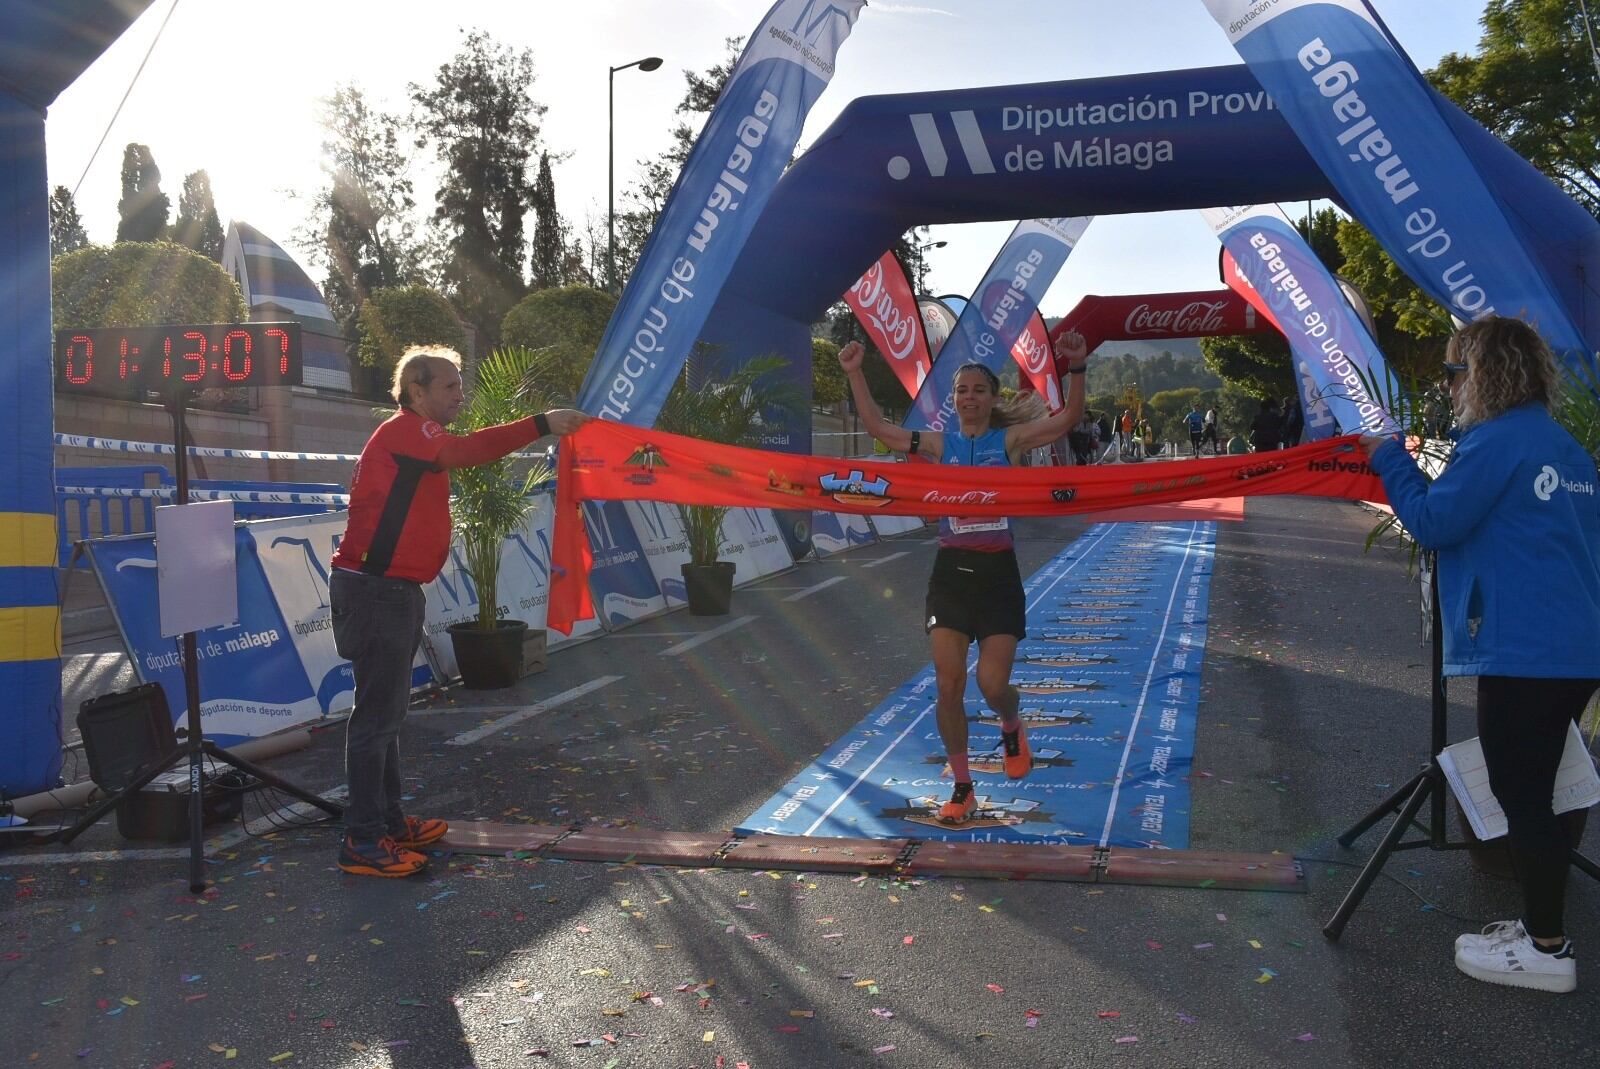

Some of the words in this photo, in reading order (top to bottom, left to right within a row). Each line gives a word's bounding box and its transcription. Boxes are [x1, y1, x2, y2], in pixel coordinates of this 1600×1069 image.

[1229, 1, 1271, 34] diputación
[1002, 93, 1178, 135] Diputación
[1188, 89, 1278, 118] Provi
[1297, 37, 1420, 205] málaga
[1004, 144, 1044, 173] de
[1054, 137, 1174, 172] Málaga
[1405, 206, 1452, 259] de
[1249, 231, 1314, 312] málaga
[1124, 301, 1229, 335] Coca-Cola
[1304, 310, 1328, 340] de
[66, 328, 290, 385] 01:13:07
[613, 550, 639, 568] málaga
[146, 646, 205, 673] diputacn
[206, 642, 223, 657] de
[225, 629, 281, 653] málaga
[200, 702, 244, 718] diputación
[246, 706, 257, 714] es
[259, 706, 293, 717] deporte
[191, 764, 200, 793] VONYX
